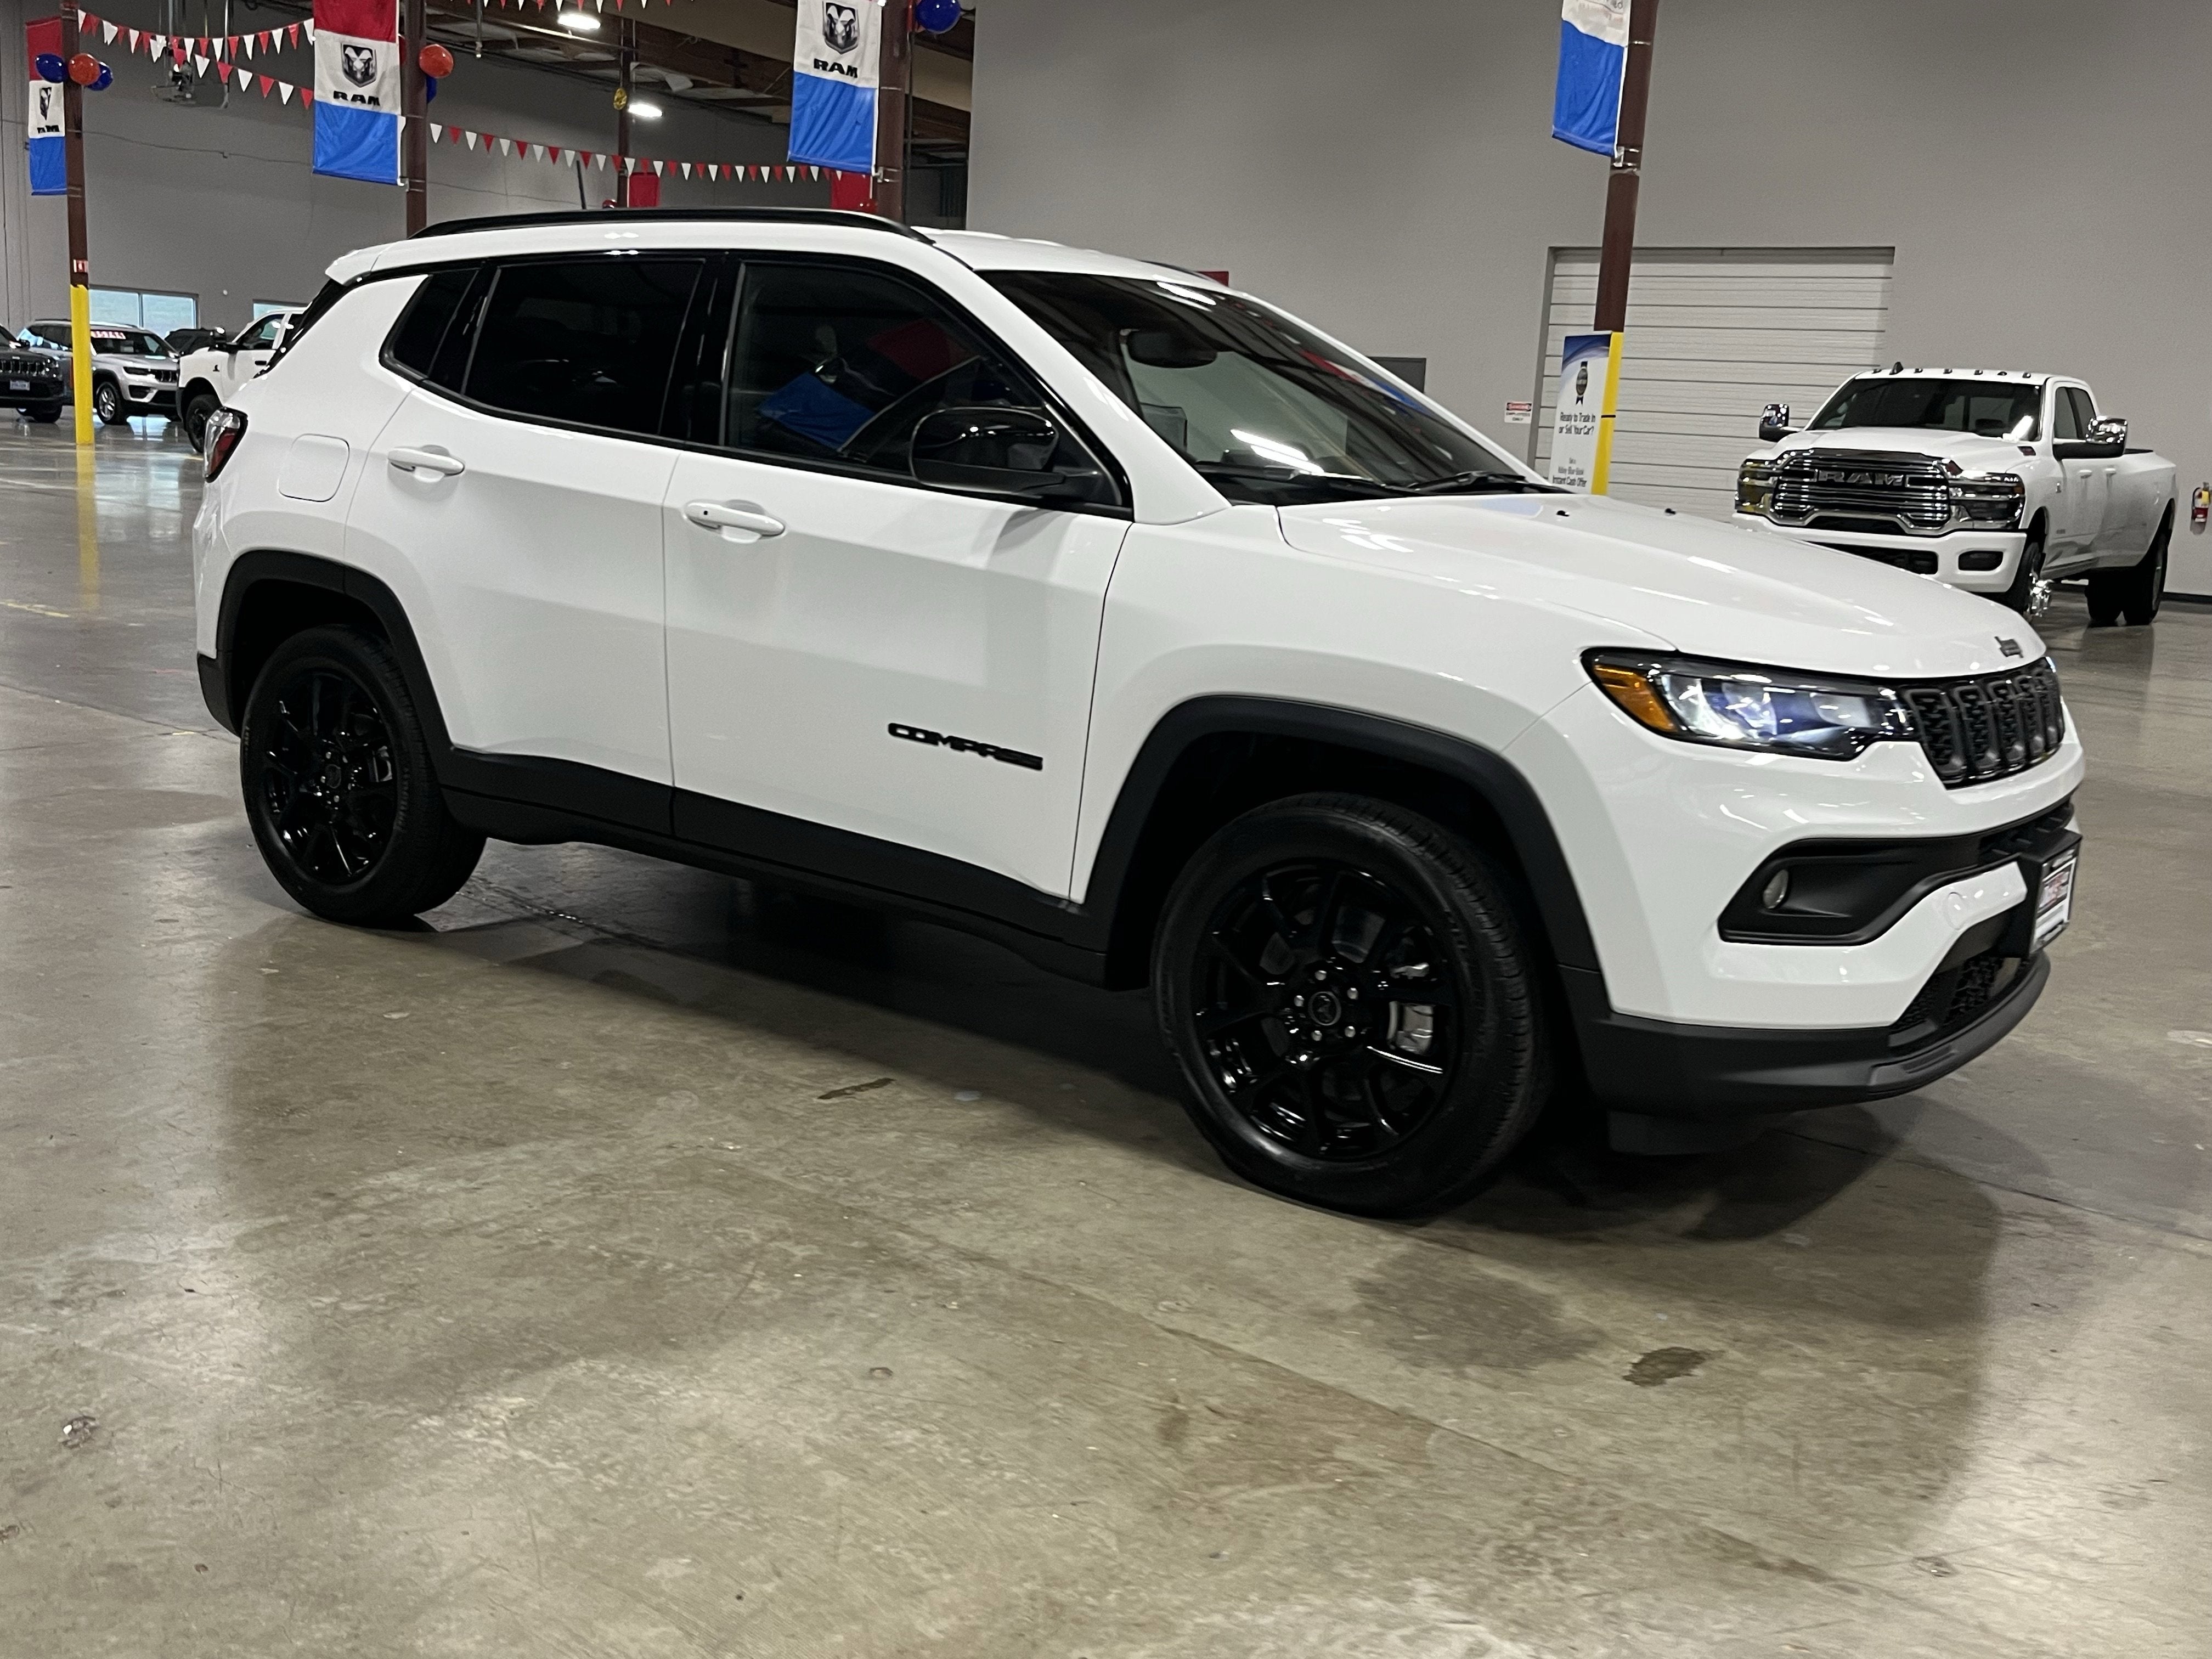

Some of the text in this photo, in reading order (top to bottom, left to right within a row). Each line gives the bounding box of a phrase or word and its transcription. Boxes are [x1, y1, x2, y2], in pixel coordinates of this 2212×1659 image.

[814, 58, 858, 78] RAM
[333, 90, 380, 106] RAM
[1818, 470, 1904, 486] RAM
